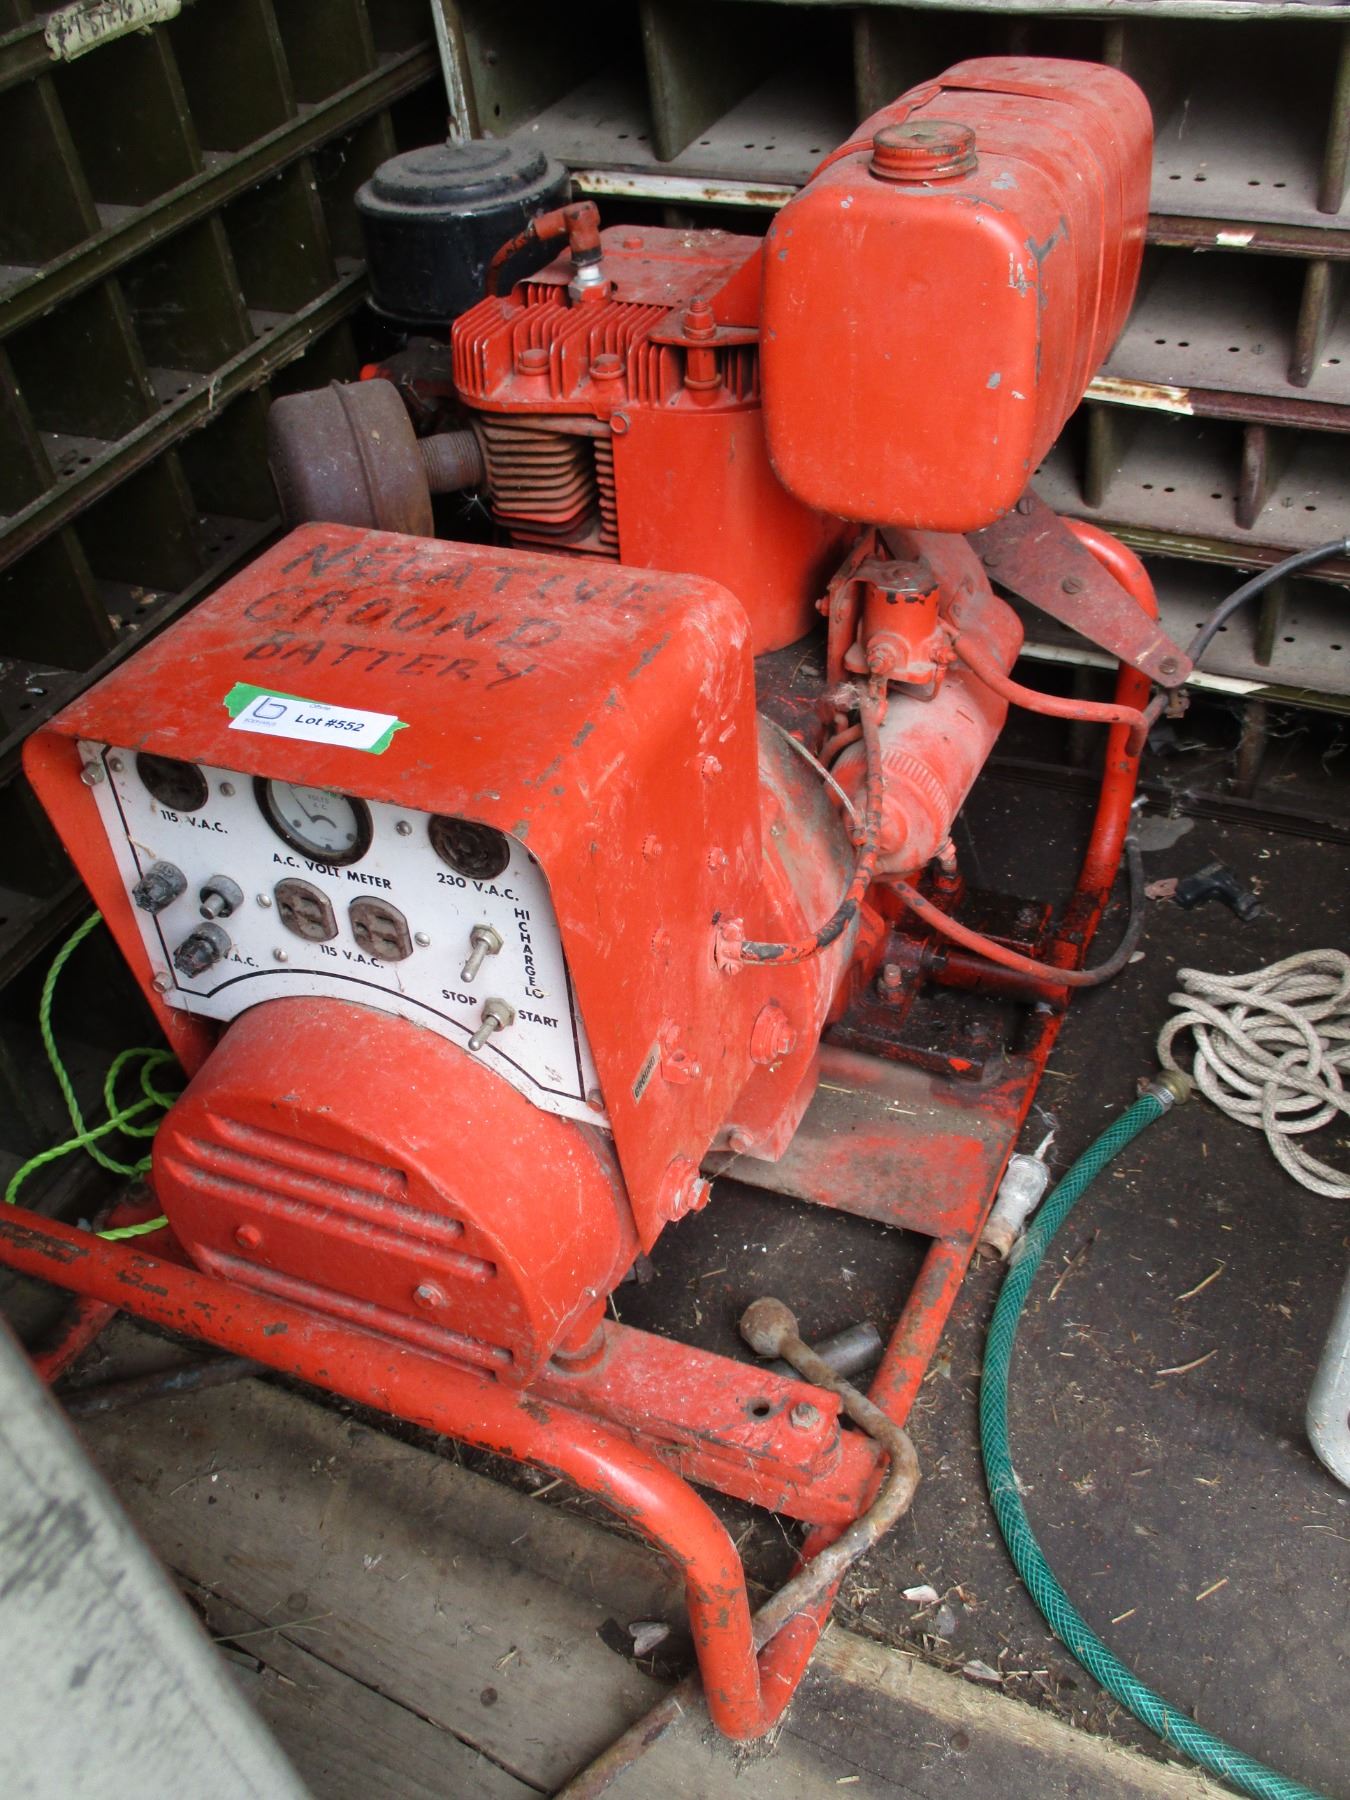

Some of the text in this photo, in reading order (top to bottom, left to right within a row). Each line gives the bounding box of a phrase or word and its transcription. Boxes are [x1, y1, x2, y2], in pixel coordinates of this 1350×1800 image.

[281, 544, 655, 610] NEGATIVE
[244, 585, 562, 649] GROUND
[243, 629, 539, 690] BATTERY
[295, 714, 365, 732] Lot #552
[160, 810, 228, 834] 115 V.A.C.
[273, 853, 392, 890] A.C. VOLT METER
[436, 872, 520, 901] 230 V.A.C.
[514, 907, 531, 921] HI
[319, 944, 384, 968] 115 V.A.C.
[518, 921, 537, 986] CHARGE
[441, 989, 477, 1006] STOP
[518, 1009, 558, 1028] START
[634, 1055, 655, 1098] GROUND
